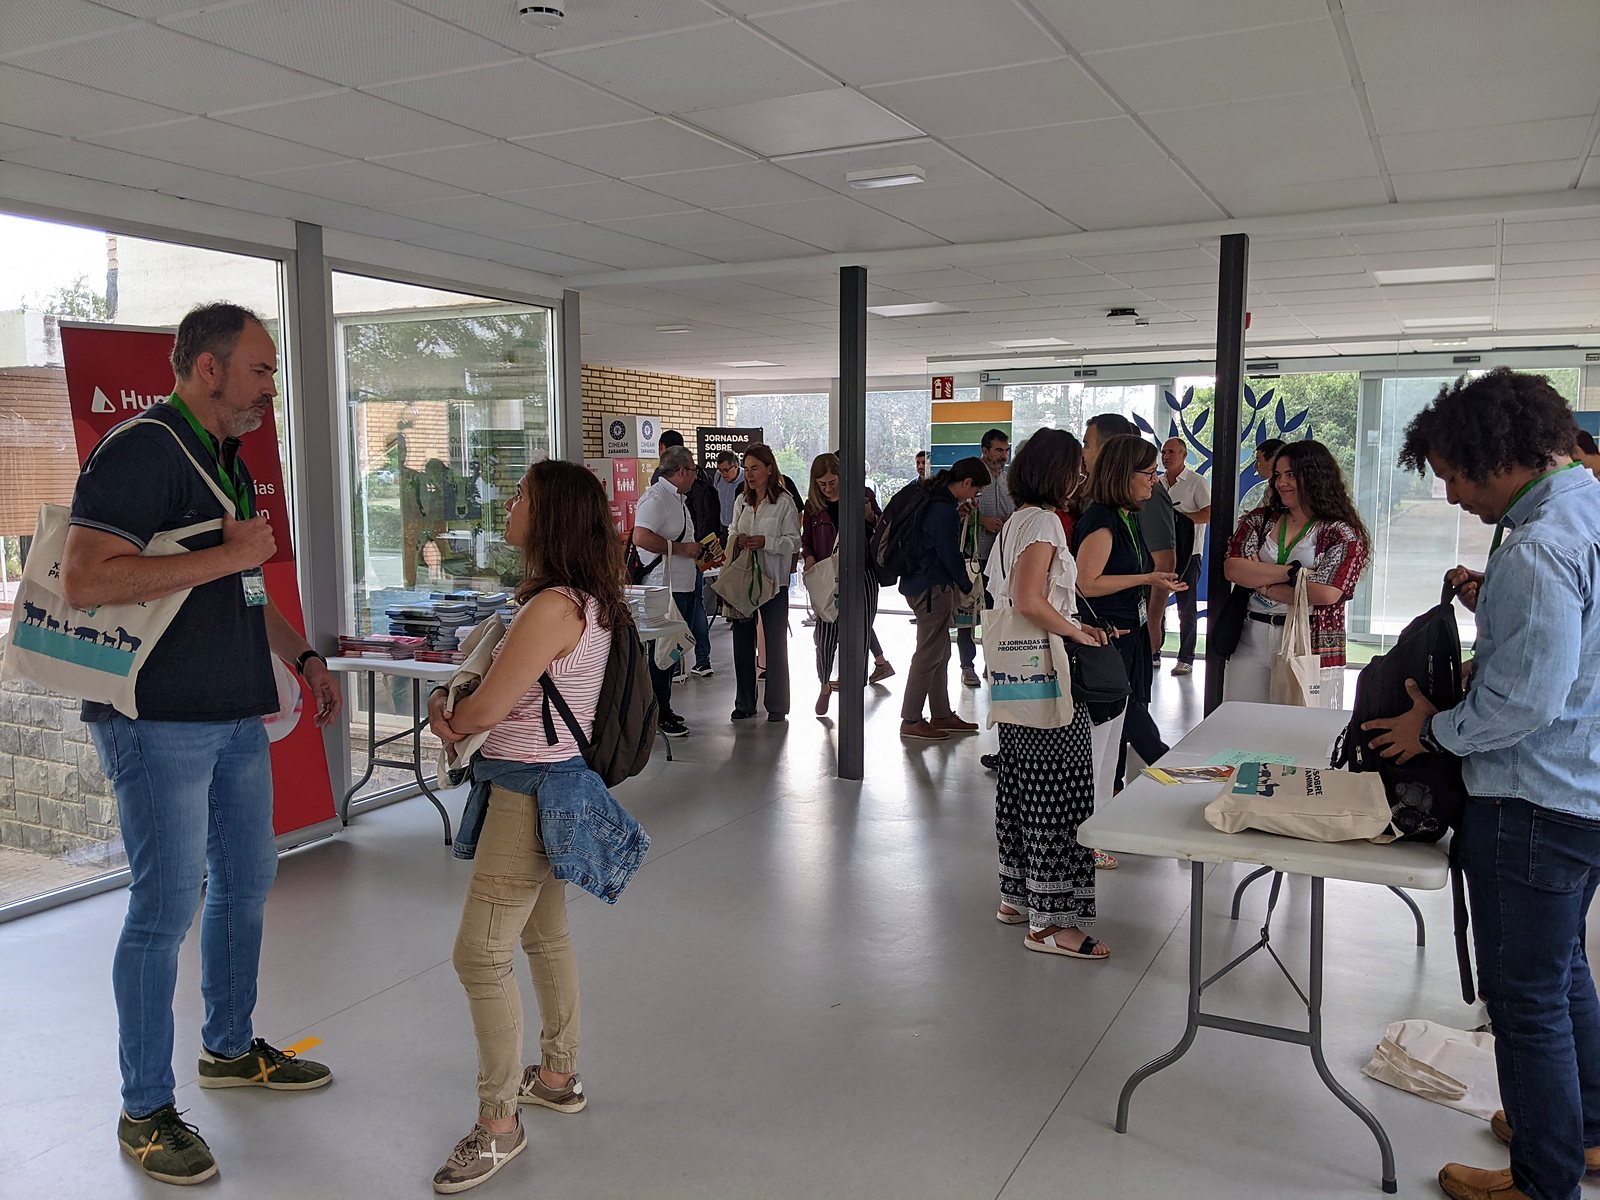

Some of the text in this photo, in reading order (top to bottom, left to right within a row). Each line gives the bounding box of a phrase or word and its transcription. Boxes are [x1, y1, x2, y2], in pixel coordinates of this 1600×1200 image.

[704, 434, 749, 443] JORNADAS
[704, 443, 733, 451] SOBRE
[615, 463, 620, 473] 1
[641, 463, 646, 473] 2
[1312, 770, 1323, 796] SOBRE
